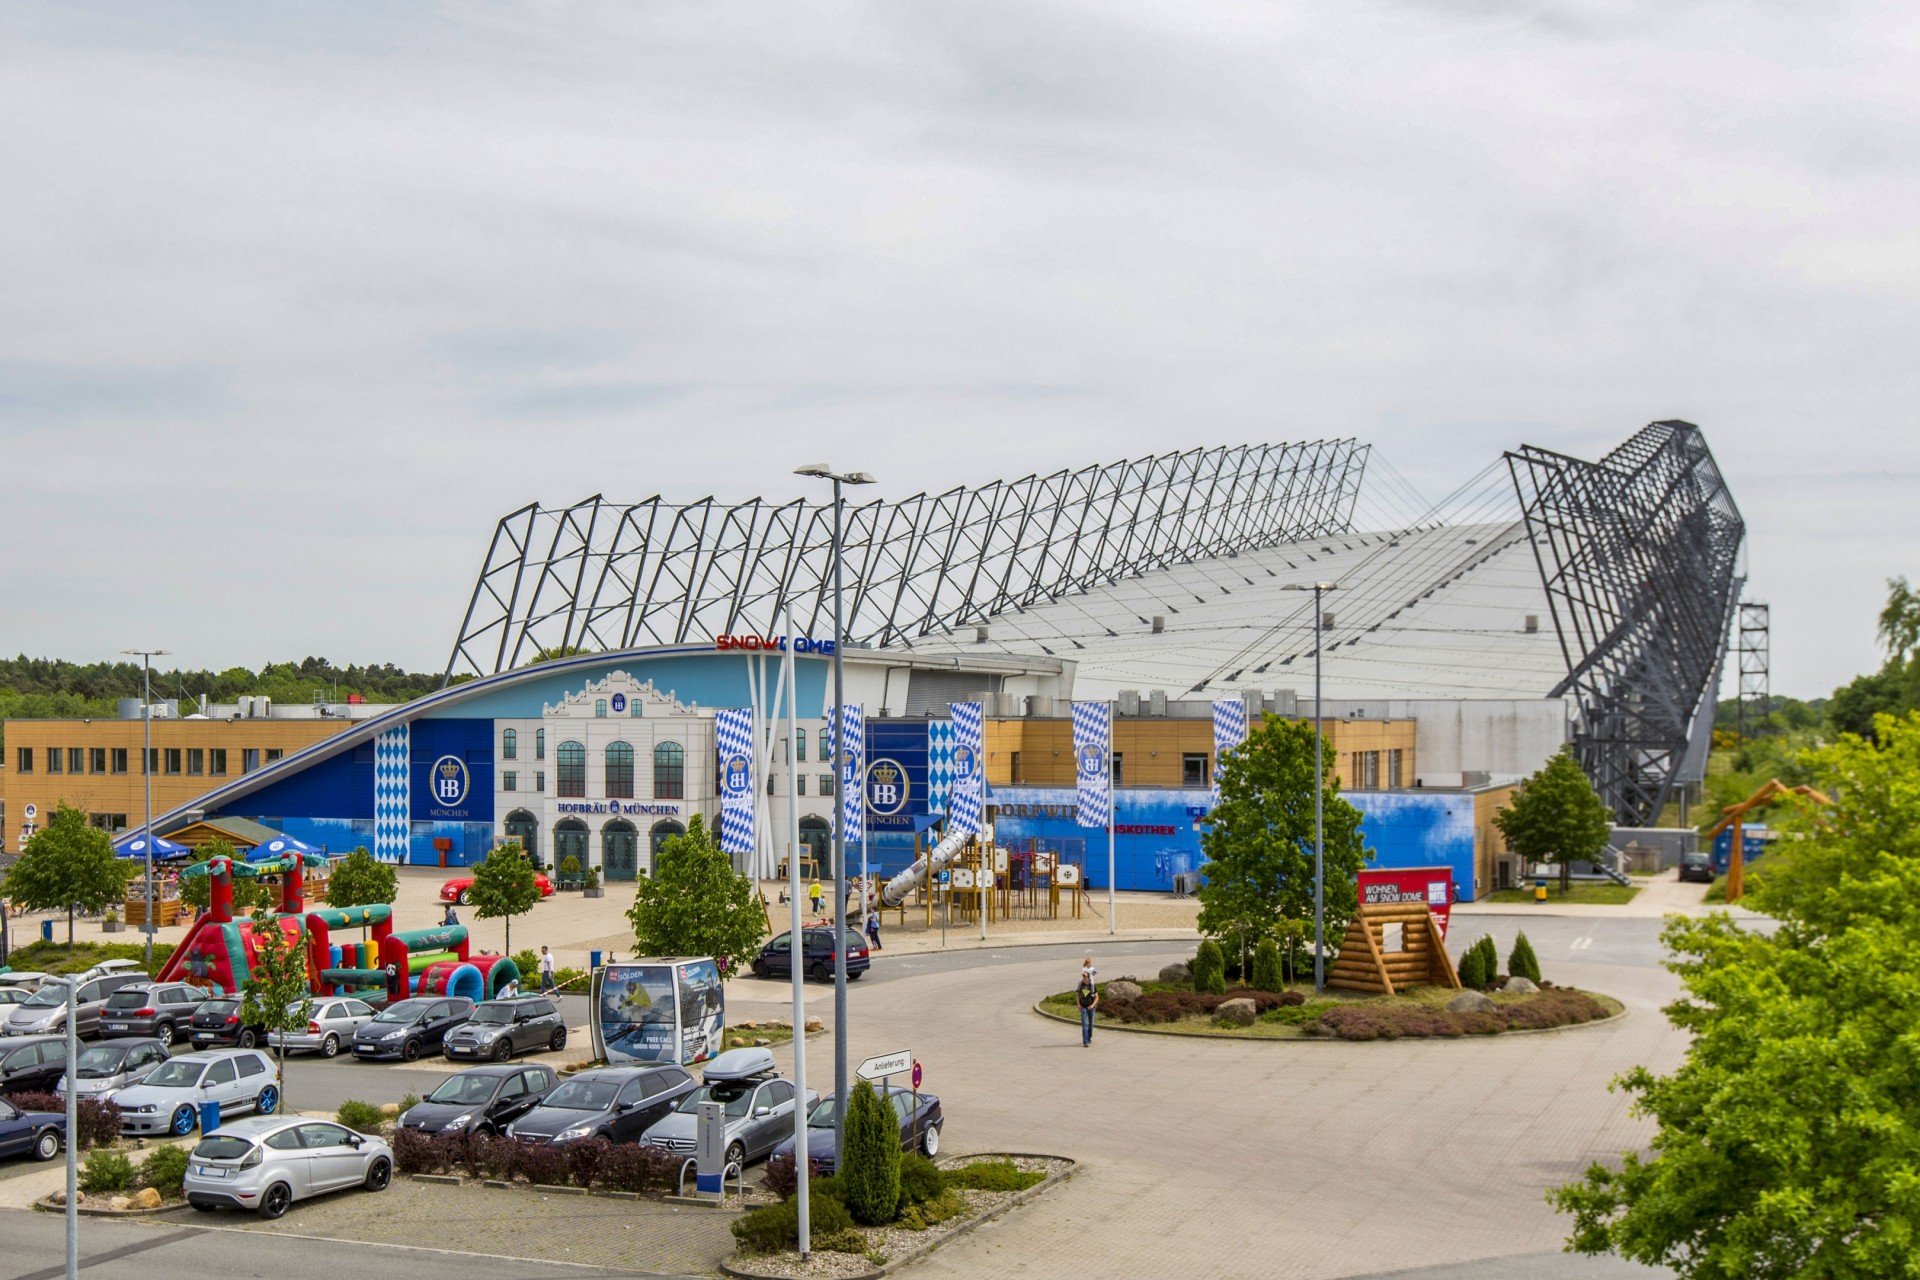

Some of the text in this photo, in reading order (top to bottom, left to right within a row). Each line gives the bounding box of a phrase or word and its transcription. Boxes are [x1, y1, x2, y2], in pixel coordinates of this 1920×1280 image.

[440, 779, 459, 798] HB
[873, 784, 897, 805] HB
[430, 809, 469, 817] MÜNCHEN
[558, 803, 607, 814] HOFBRÄU
[623, 803, 679, 815] MÜNCHEN
[1186, 806, 1207, 817] ICE
[941, 872, 948, 881] P
[1365, 885, 1398, 894] WOHNEN
[1366, 892, 1423, 903] AM SNOW DOME
[619, 971, 643, 981] SÖLDEN
[874, 1059, 904, 1071] Anlieferung
